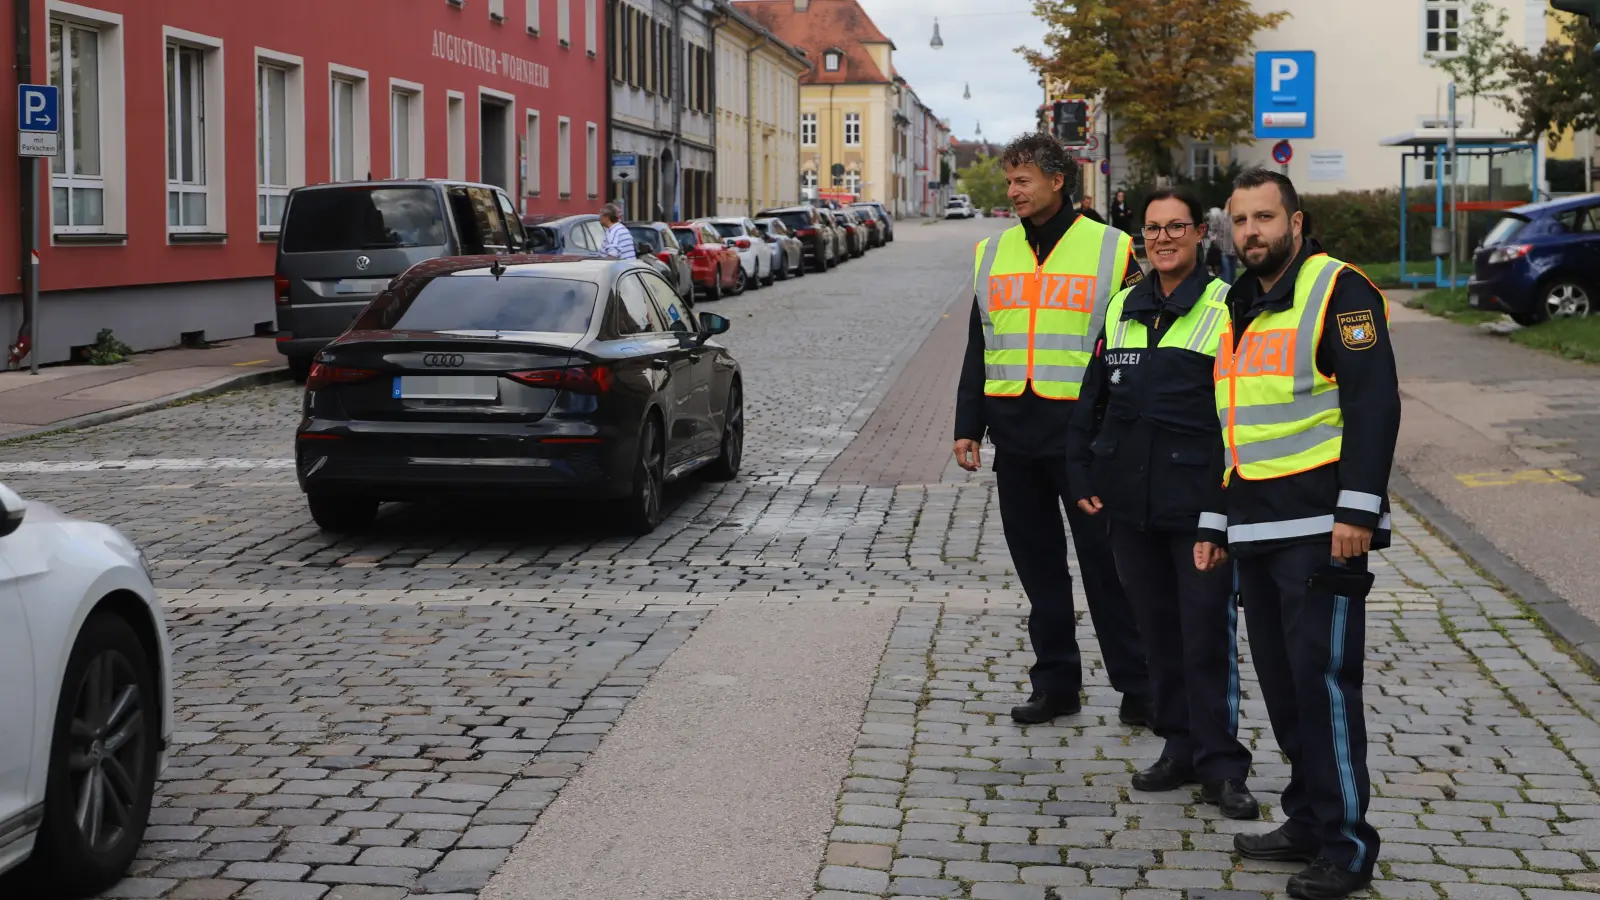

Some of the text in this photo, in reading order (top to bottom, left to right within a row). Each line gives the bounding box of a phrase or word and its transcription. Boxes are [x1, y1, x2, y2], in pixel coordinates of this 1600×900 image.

[431, 29, 549, 88] AUGUSTINER-WOHNHEIM
[1270, 58, 1298, 92] P
[25, 91, 46, 124] P
[22, 144, 56, 152] Parkschein
[990, 275, 1094, 310] POLIZEI
[1340, 313, 1370, 324] POLIZEI
[1217, 332, 1291, 376] LIZEI
